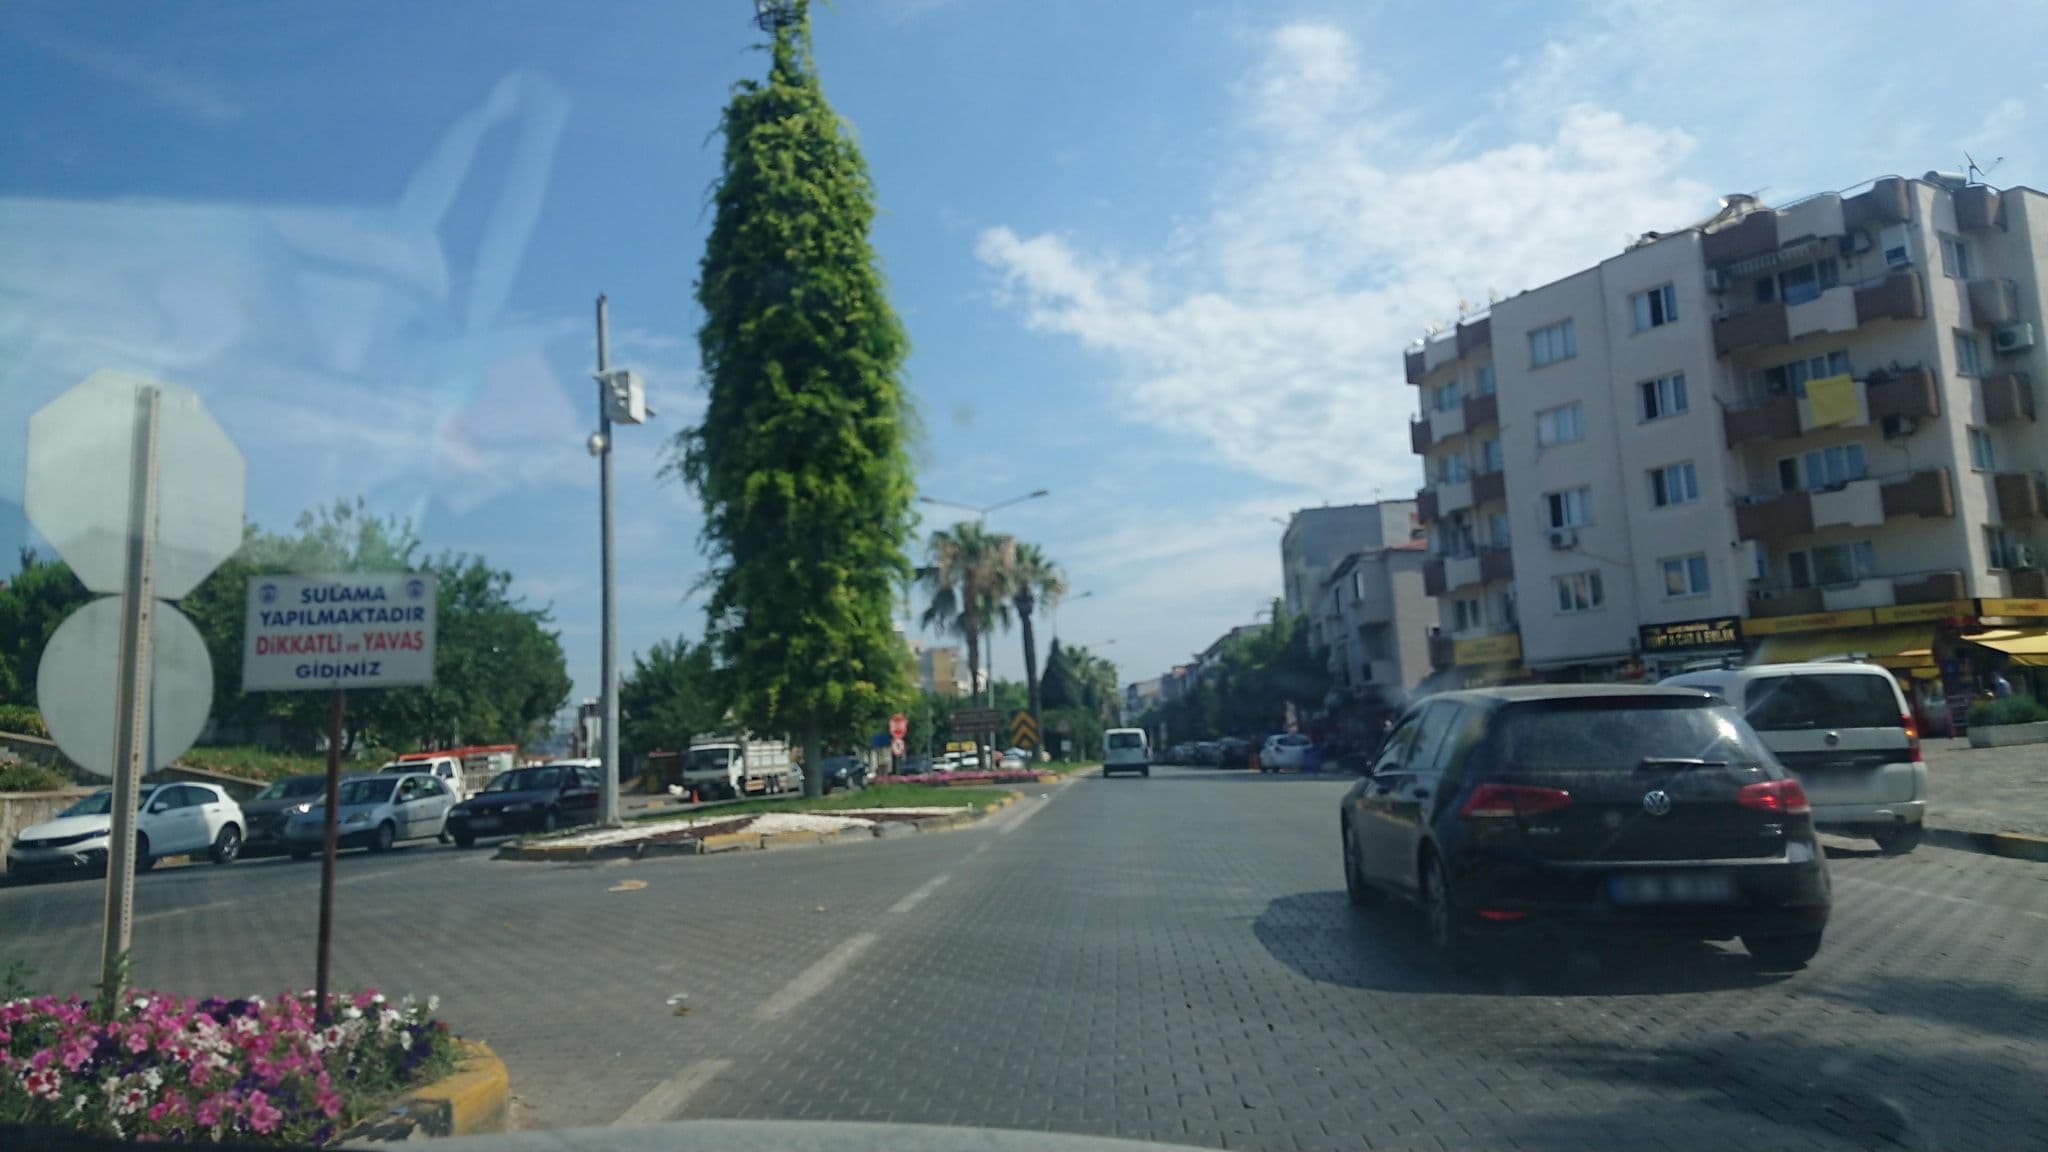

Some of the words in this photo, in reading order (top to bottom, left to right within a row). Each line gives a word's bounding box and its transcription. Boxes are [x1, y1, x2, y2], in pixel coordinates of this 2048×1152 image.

[300, 585, 386, 604] SULAMA
[259, 606, 425, 627] YAPILMAKTADIR
[345, 642, 360, 653] ve
